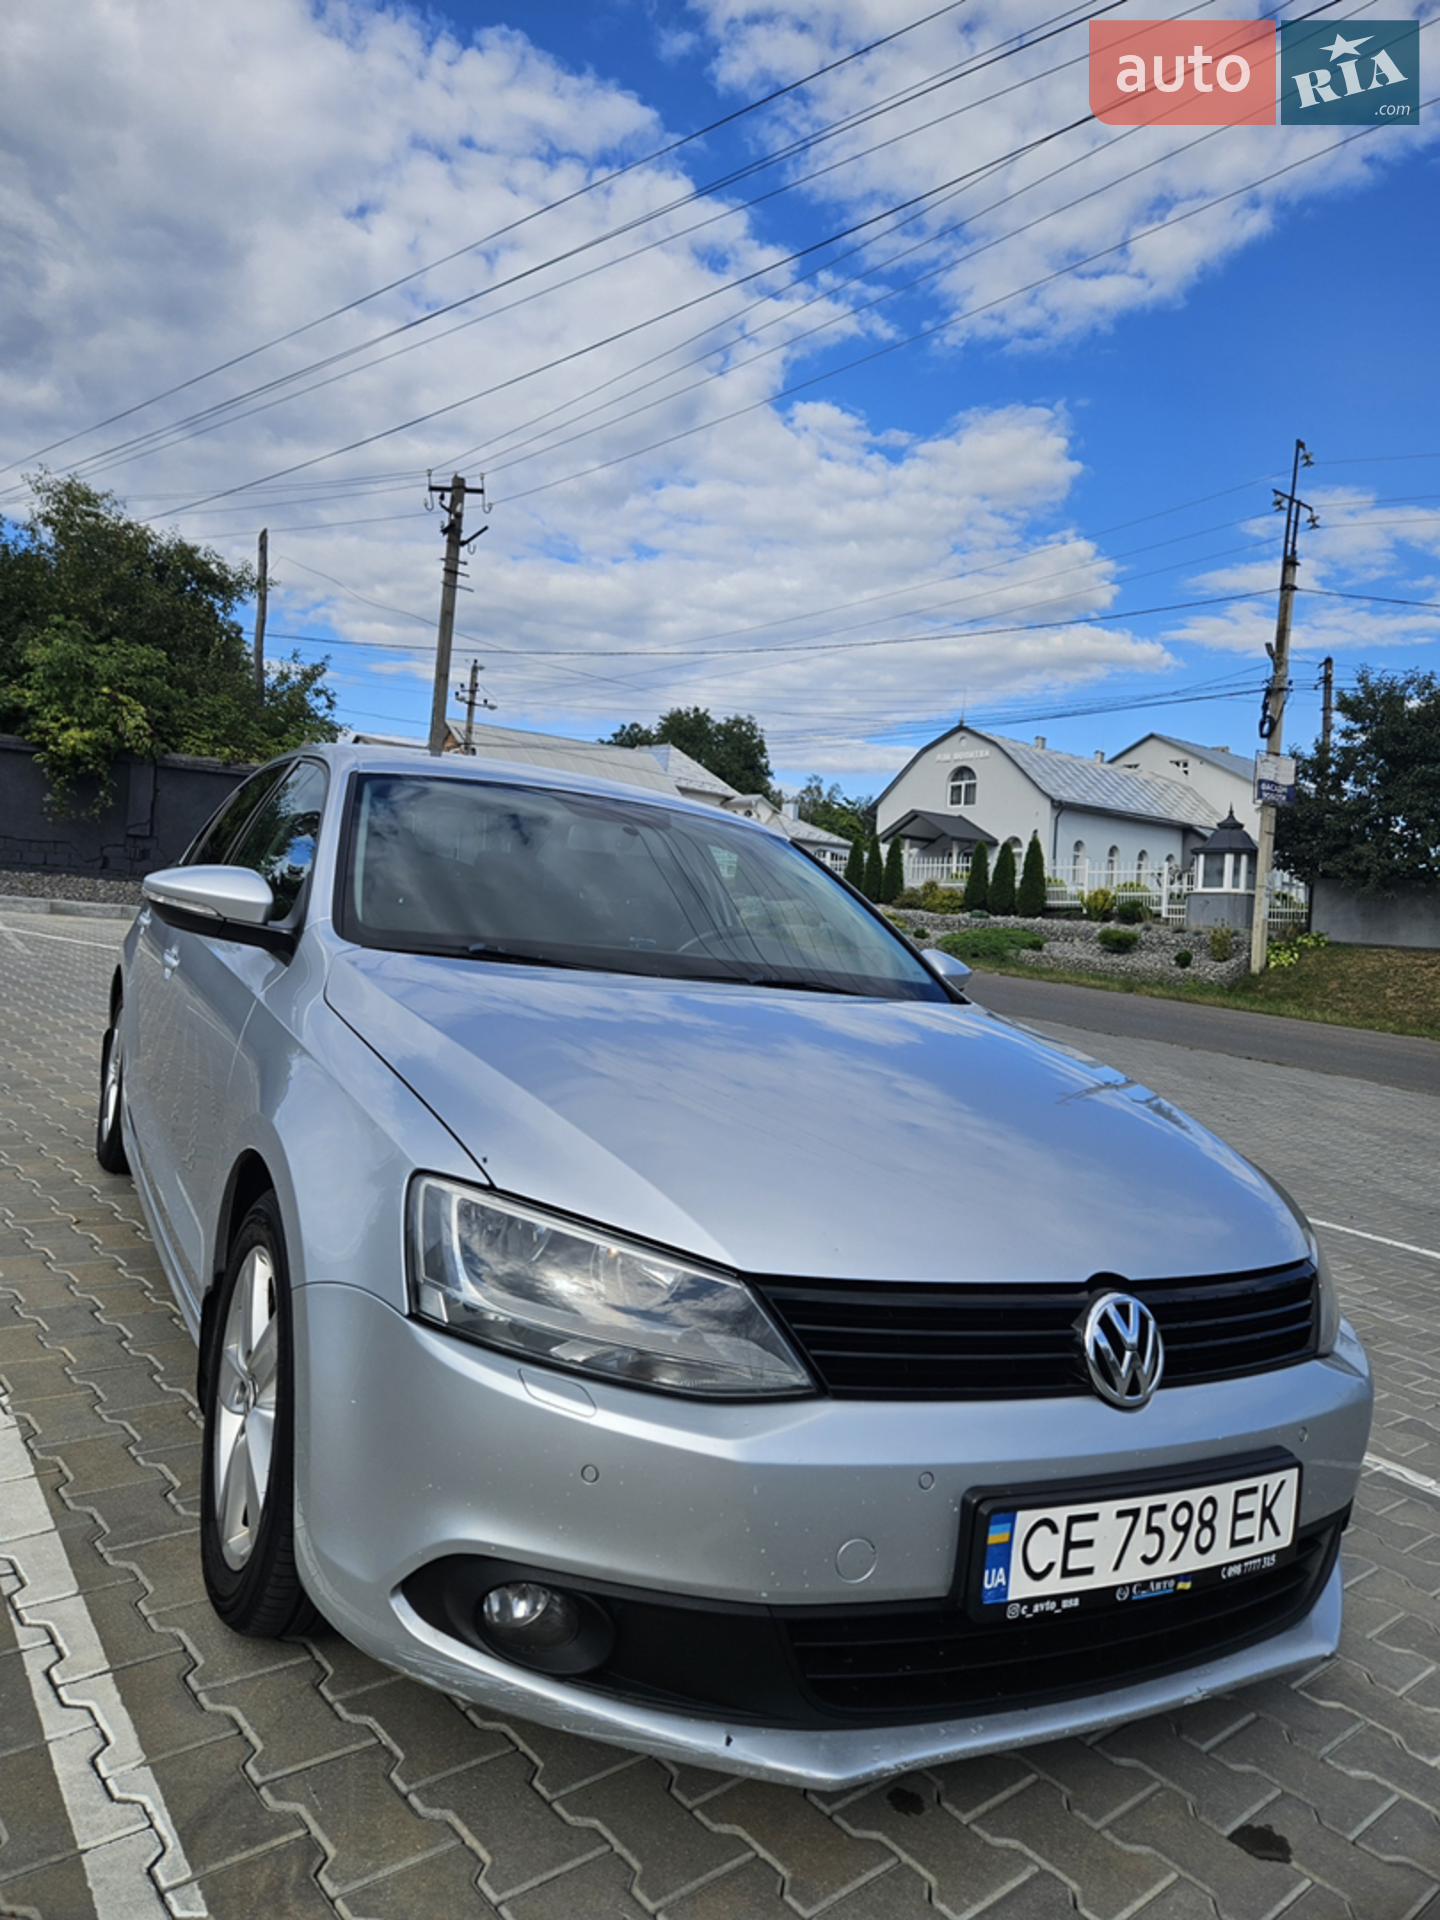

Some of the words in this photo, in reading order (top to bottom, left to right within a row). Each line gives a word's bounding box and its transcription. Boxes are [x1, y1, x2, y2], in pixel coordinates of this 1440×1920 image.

[1021, 1512, 1100, 1582] CE
[1111, 1495, 1218, 1573] 7598
[1229, 1478, 1287, 1549] EK
[984, 1567, 1006, 1589] UA
